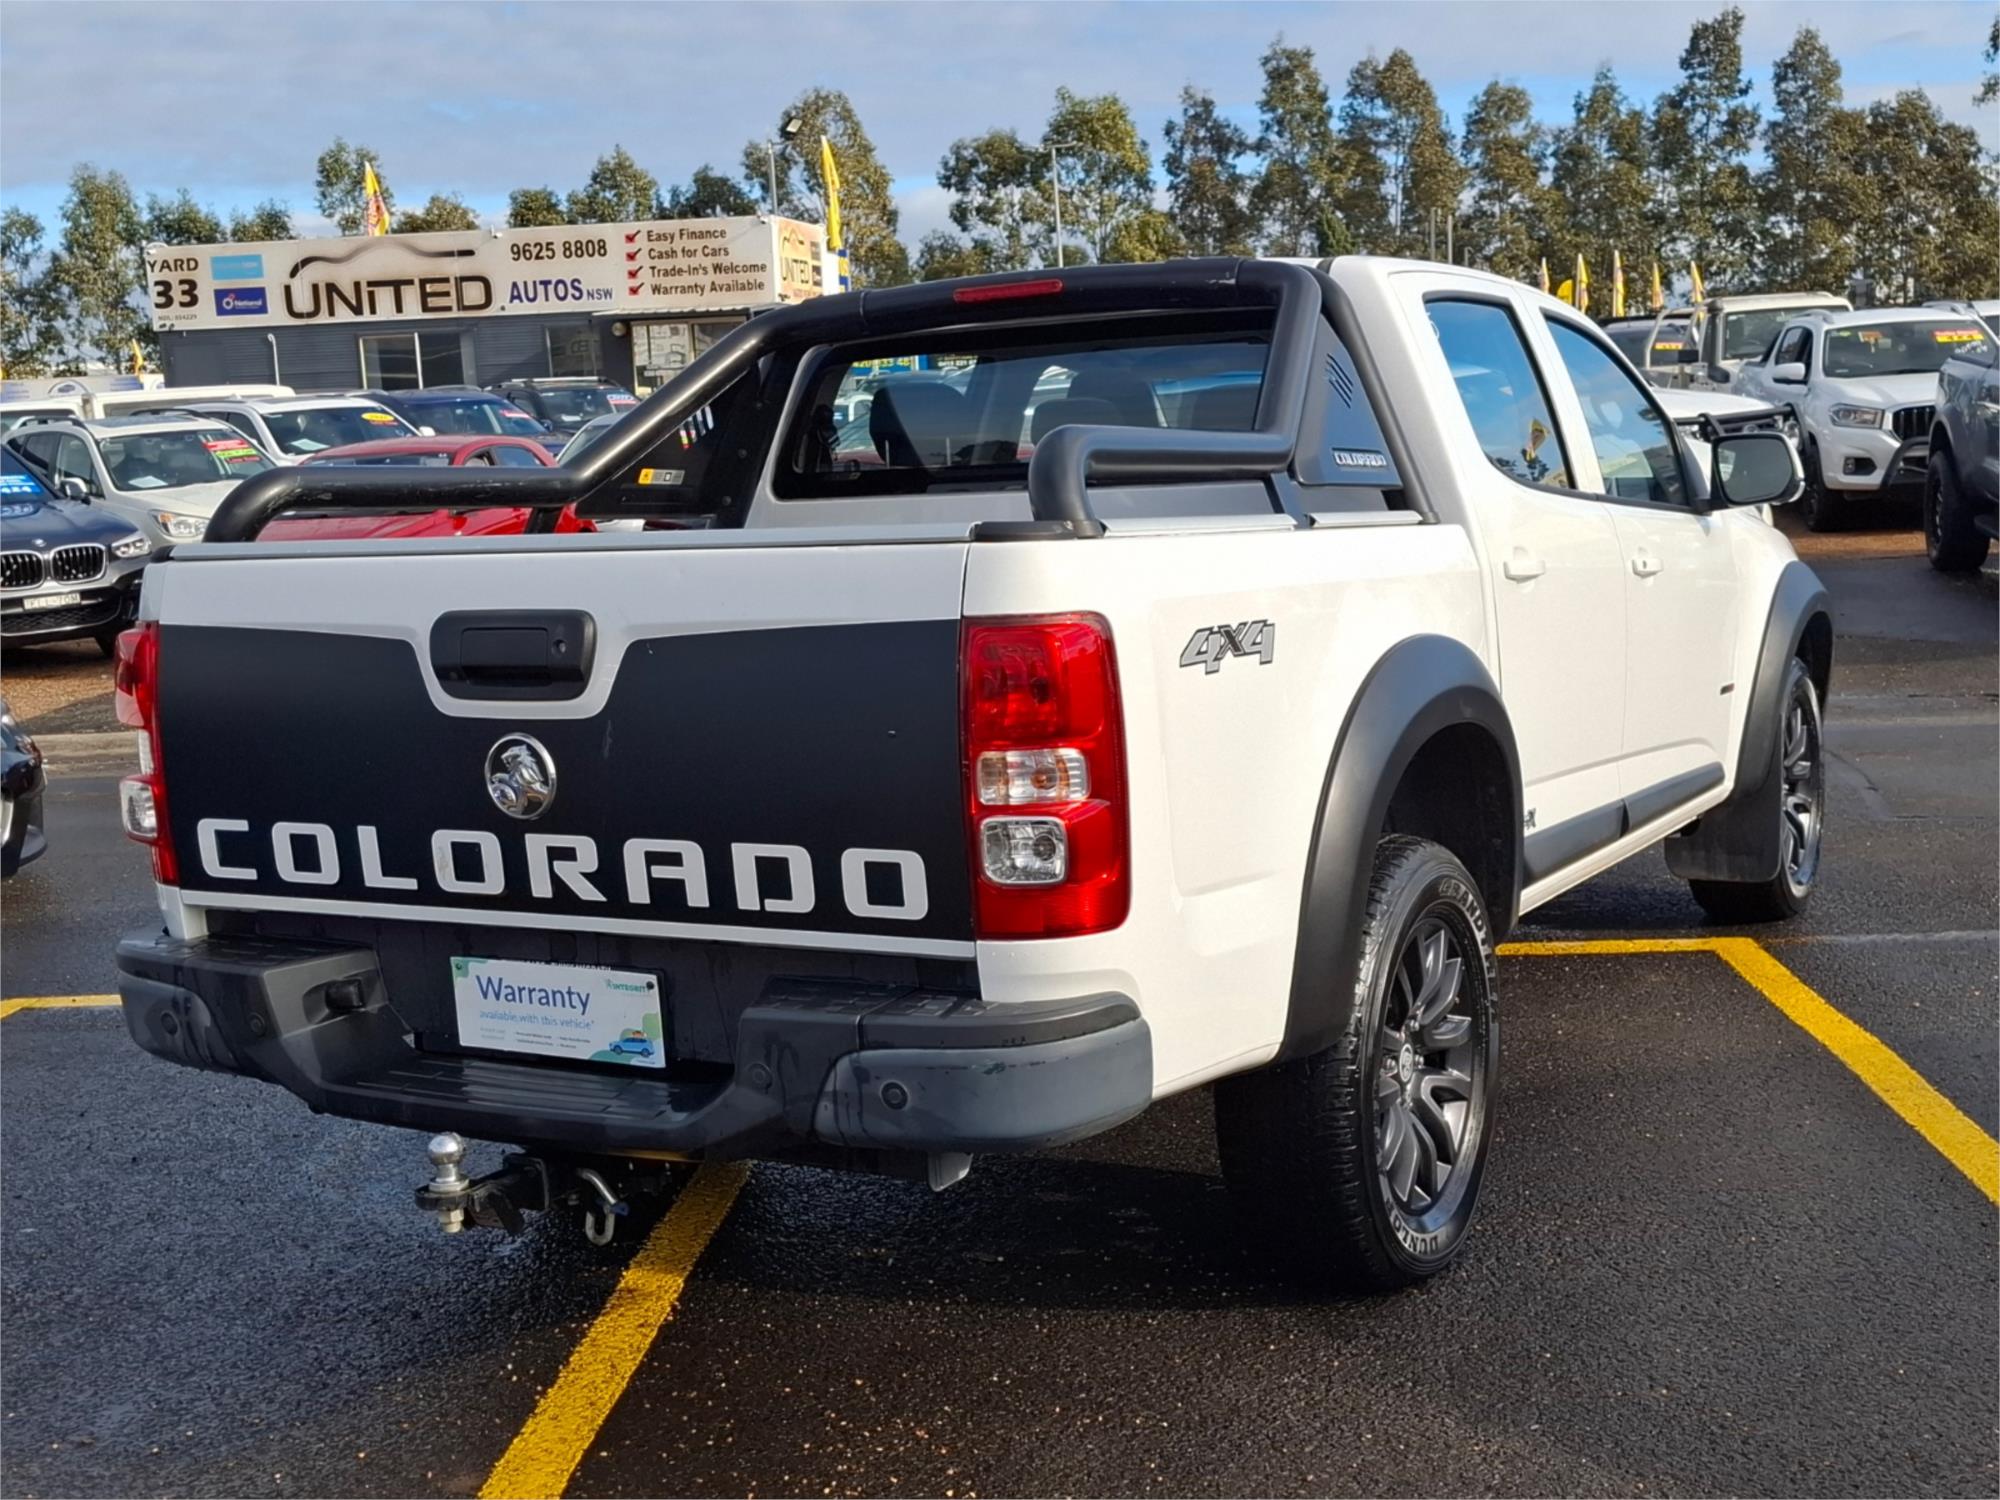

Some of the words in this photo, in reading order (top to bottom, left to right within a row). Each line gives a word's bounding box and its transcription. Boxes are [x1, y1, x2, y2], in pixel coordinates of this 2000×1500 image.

[647, 230, 675, 244] Easy
[679, 228, 727, 241] Finance
[510, 241, 556, 261] 9625
[562, 239, 607, 259] 8808
[648, 248, 679, 260] Cash
[681, 247, 700, 259] for
[702, 246, 730, 258] Cars
[147, 257, 199, 273] YARD
[650, 265, 708, 278] Trade-In's
[712, 262, 767, 275] Welcome
[153, 278, 199, 309] 33
[509, 278, 583, 303] AUTOS
[586, 288, 613, 301] NSW
[650, 282, 705, 297] Warranty
[709, 279, 765, 294] Available
[197, 817, 929, 920] COLORADO
[476, 974, 591, 1016] Warranty
[519, 1013, 540, 1025] with
[540, 1015, 558, 1026] this
